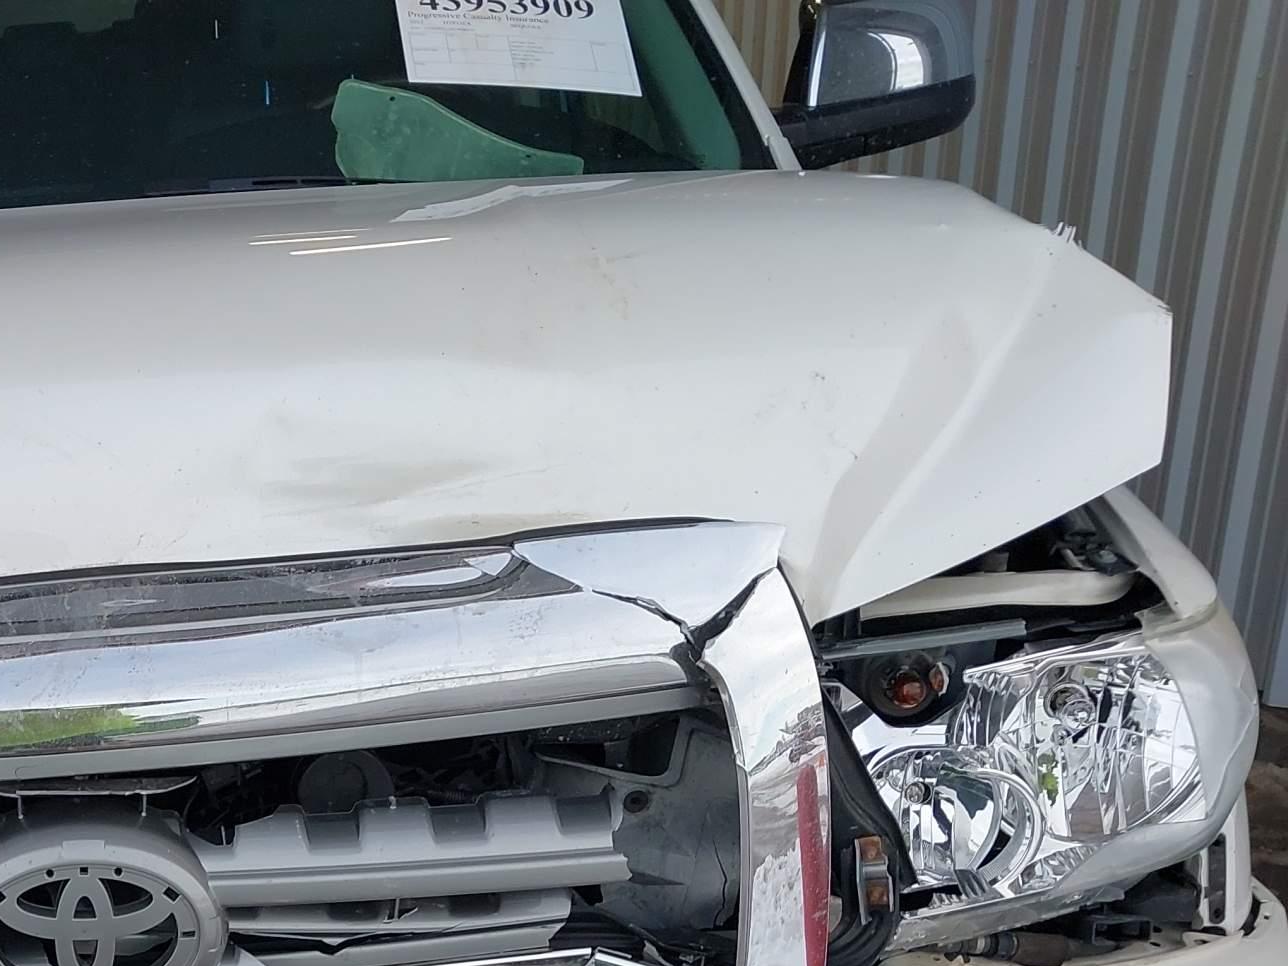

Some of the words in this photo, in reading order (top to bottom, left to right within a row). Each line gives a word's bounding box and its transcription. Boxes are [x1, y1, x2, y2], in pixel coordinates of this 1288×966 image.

[408, 11, 461, 19] Progressive
[463, 13, 502, 21] Casualty
[505, 15, 549, 23] Insurance
